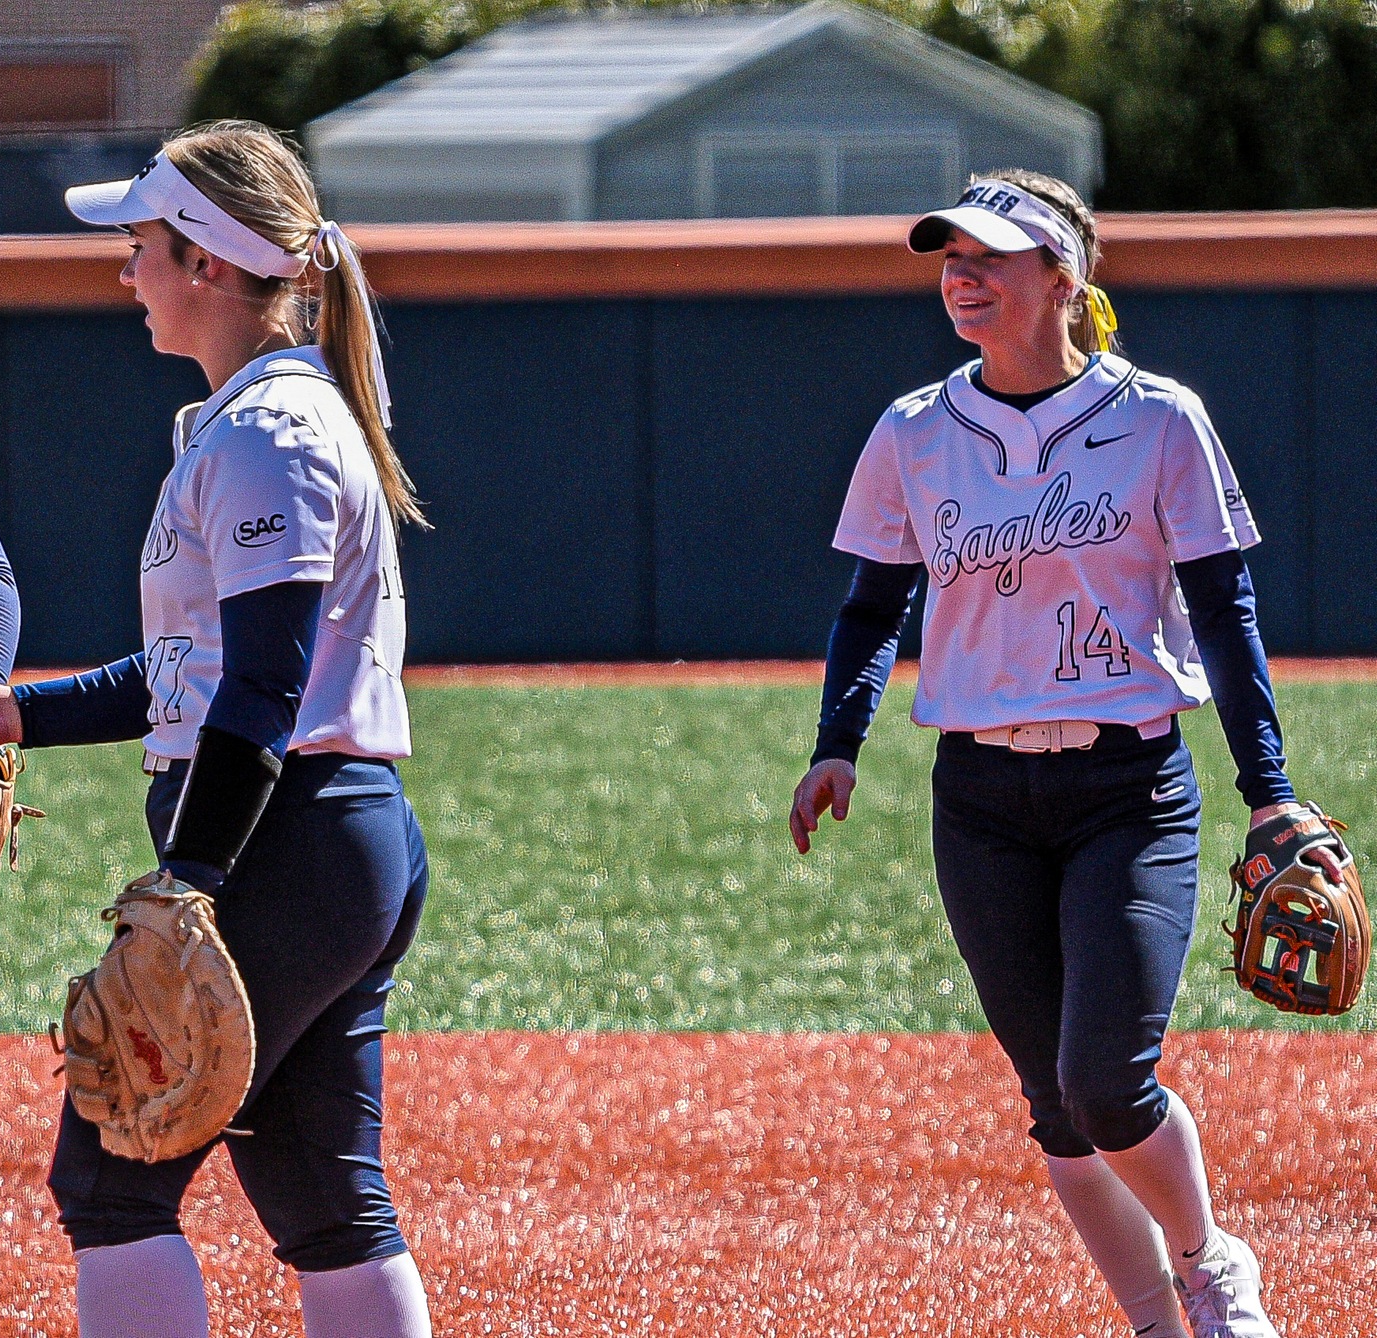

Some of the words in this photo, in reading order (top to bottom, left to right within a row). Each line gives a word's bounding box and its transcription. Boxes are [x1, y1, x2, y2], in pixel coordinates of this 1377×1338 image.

[239, 513, 287, 541] SAC
[931, 471, 1132, 597] Eagles
[1055, 601, 1131, 681] 14
